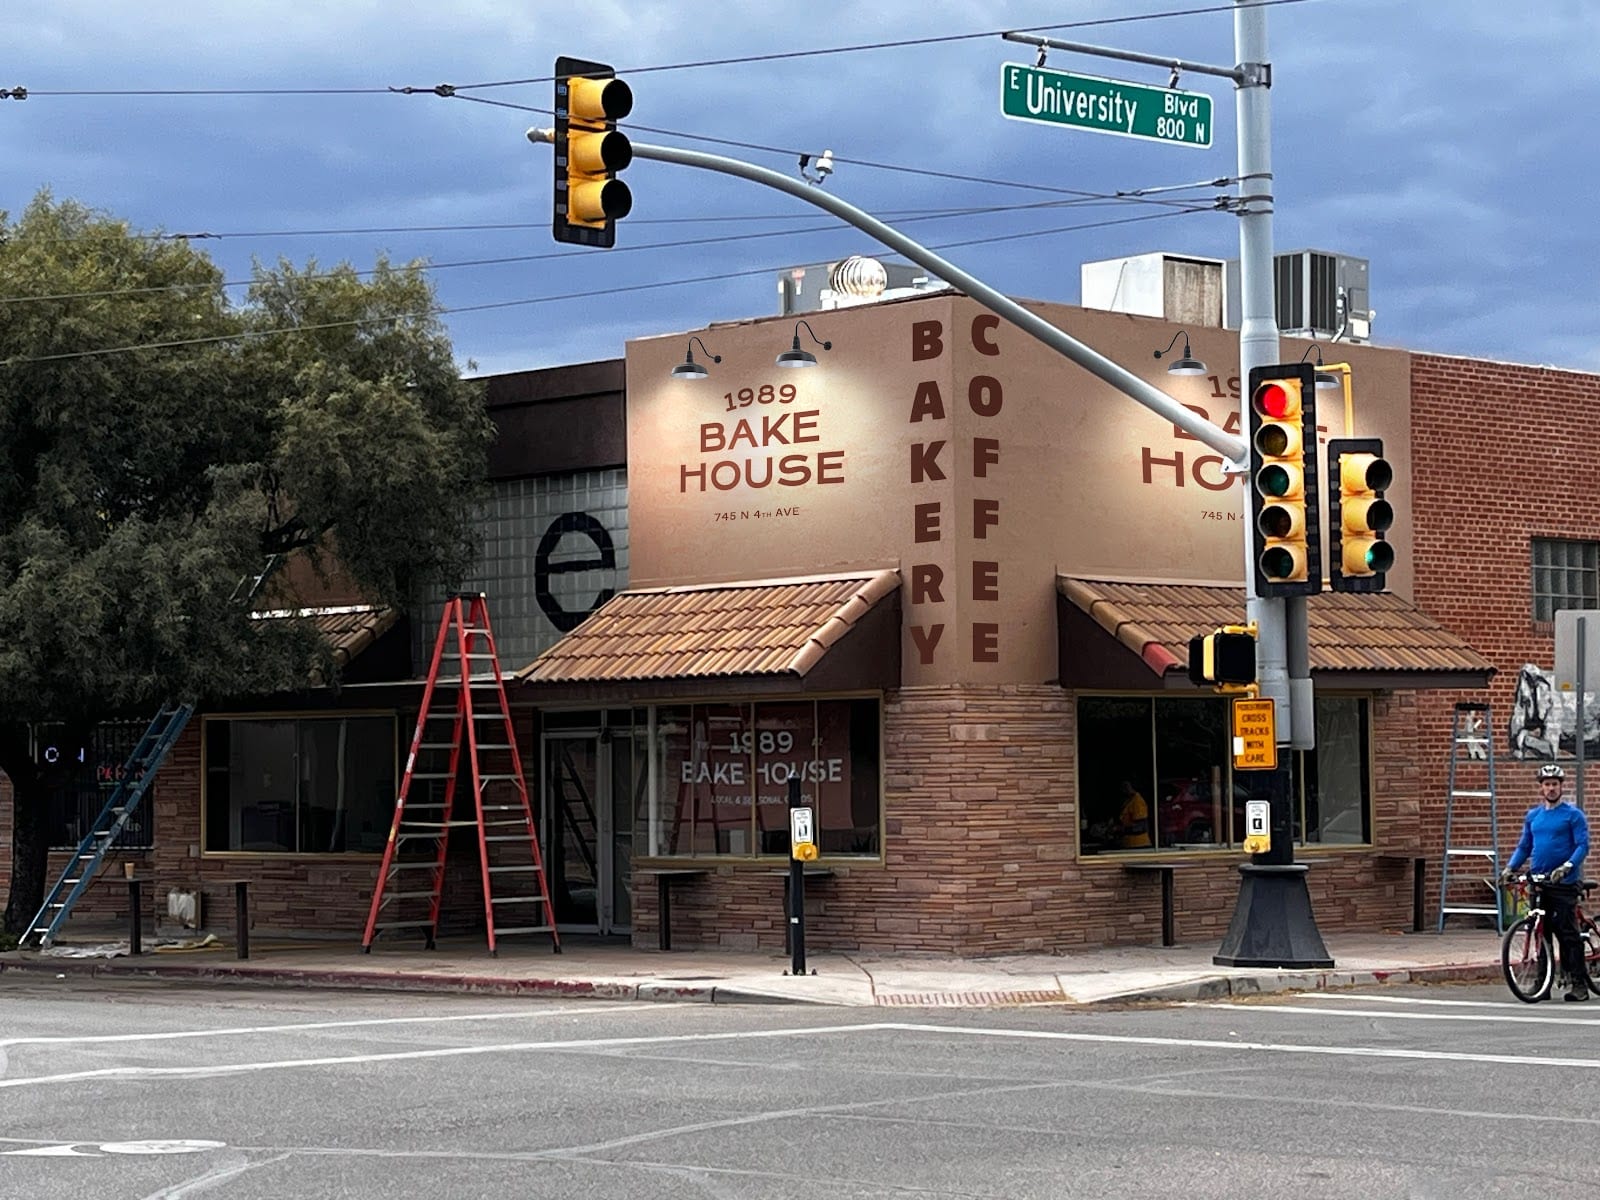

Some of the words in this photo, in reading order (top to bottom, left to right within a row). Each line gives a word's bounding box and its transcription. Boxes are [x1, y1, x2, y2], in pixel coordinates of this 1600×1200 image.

[1010, 69, 1020, 90] E
[1026, 73, 1138, 134] University
[1164, 93, 1199, 118] Blvd
[1156, 117, 1185, 140] 800
[1195, 123, 1205, 143] N
[723, 384, 797, 412] 1989
[700, 409, 820, 453] BAKE
[680, 450, 845, 493] HOUSE
[909, 319, 947, 664] BAKERY
[968, 313, 1003, 663] COFFEE
[714, 512, 737, 522] 745
[740, 511, 749, 520] N
[775, 506, 800, 517] AVE
[1201, 510, 1223, 521] 745
[1227, 512, 1236, 521] N
[1241, 713, 1267, 723] CROSS
[730, 731, 793, 754] 1989
[1240, 727, 1270, 736] TRACKS
[1246, 740, 1265, 749] WITH
[1245, 753, 1265, 763] CARE
[681, 761, 745, 786] BAKE
[756, 758, 843, 785] HOUSE
